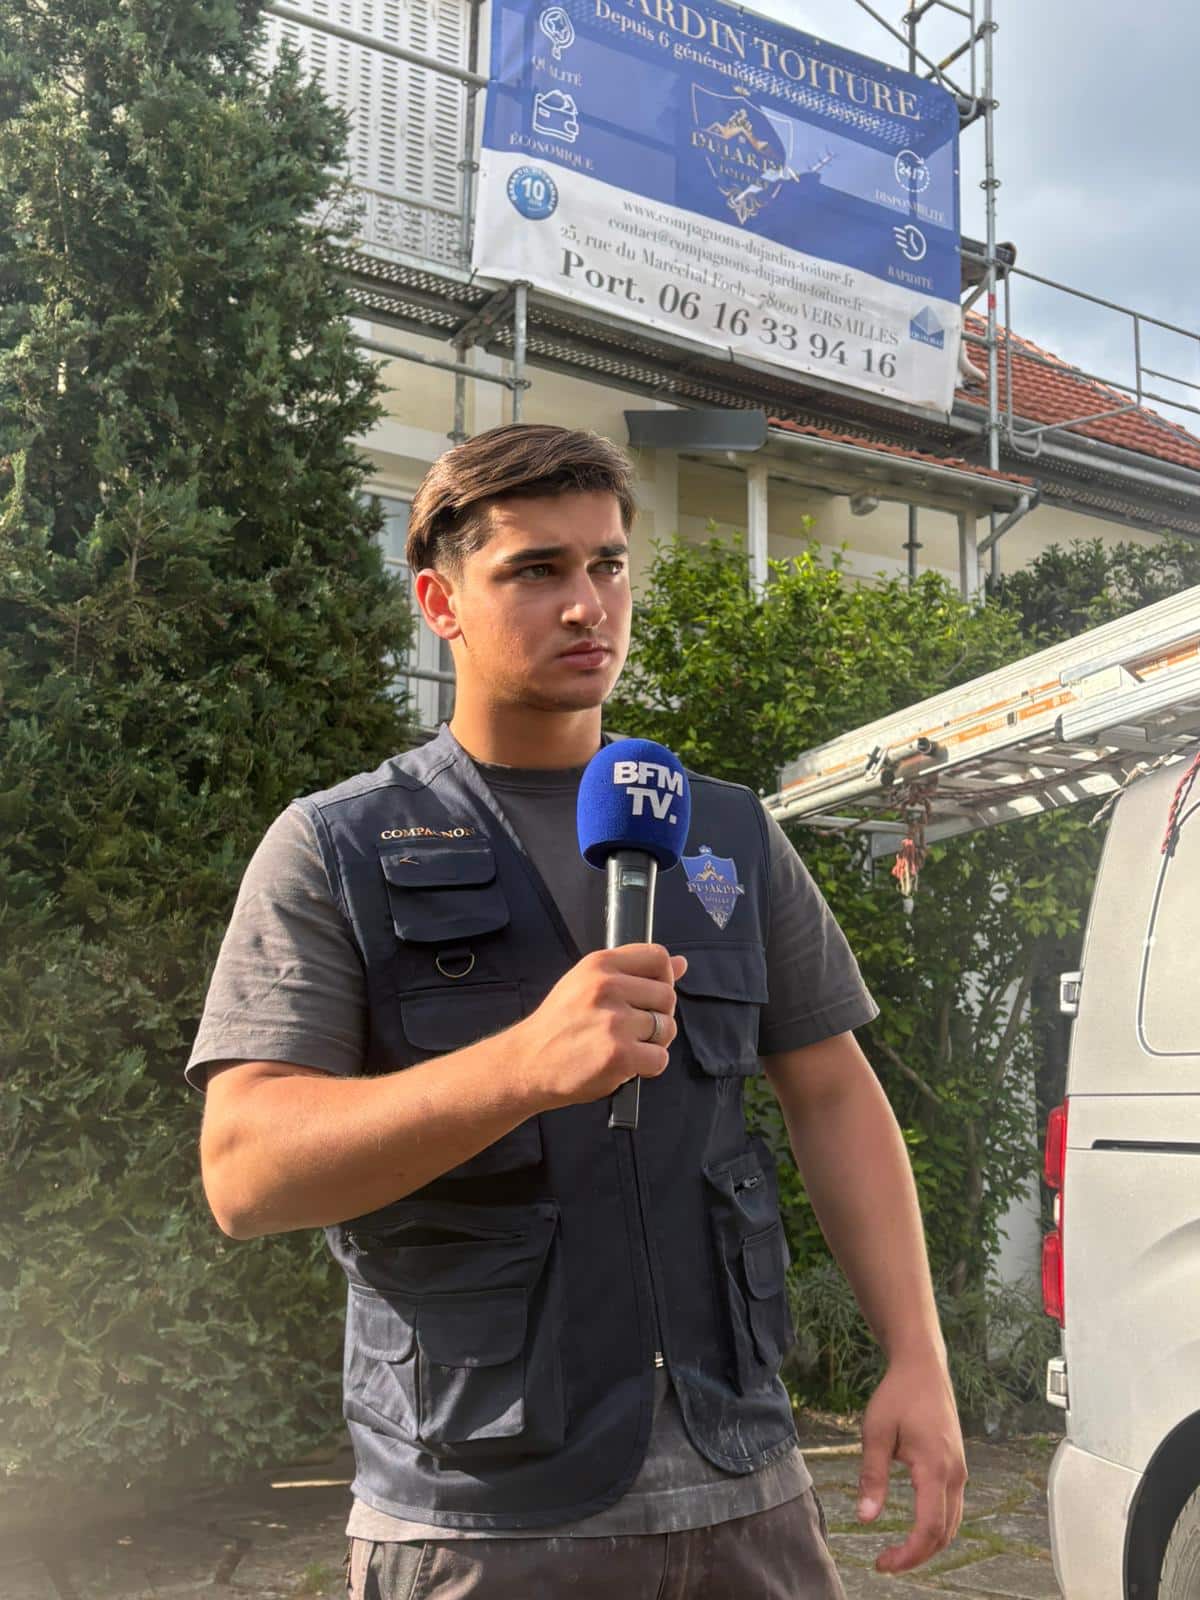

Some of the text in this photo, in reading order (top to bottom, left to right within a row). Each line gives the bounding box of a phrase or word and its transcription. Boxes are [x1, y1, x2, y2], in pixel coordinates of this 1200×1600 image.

[595, 0, 655, 42] Depuis
[658, 31, 670, 48] 6
[752, 37, 922, 121] TOITURE
[521, 177, 546, 201] 10
[560, 248, 897, 379] Port. 06 16 33 94 16
[585, 234, 612, 250] rue
[616, 242, 637, 262] du
[642, 248, 708, 286] Maréchal
[800, 303, 900, 346] VERSAILLES
[613, 761, 684, 797] BFM
[626, 787, 677, 825] TV.
